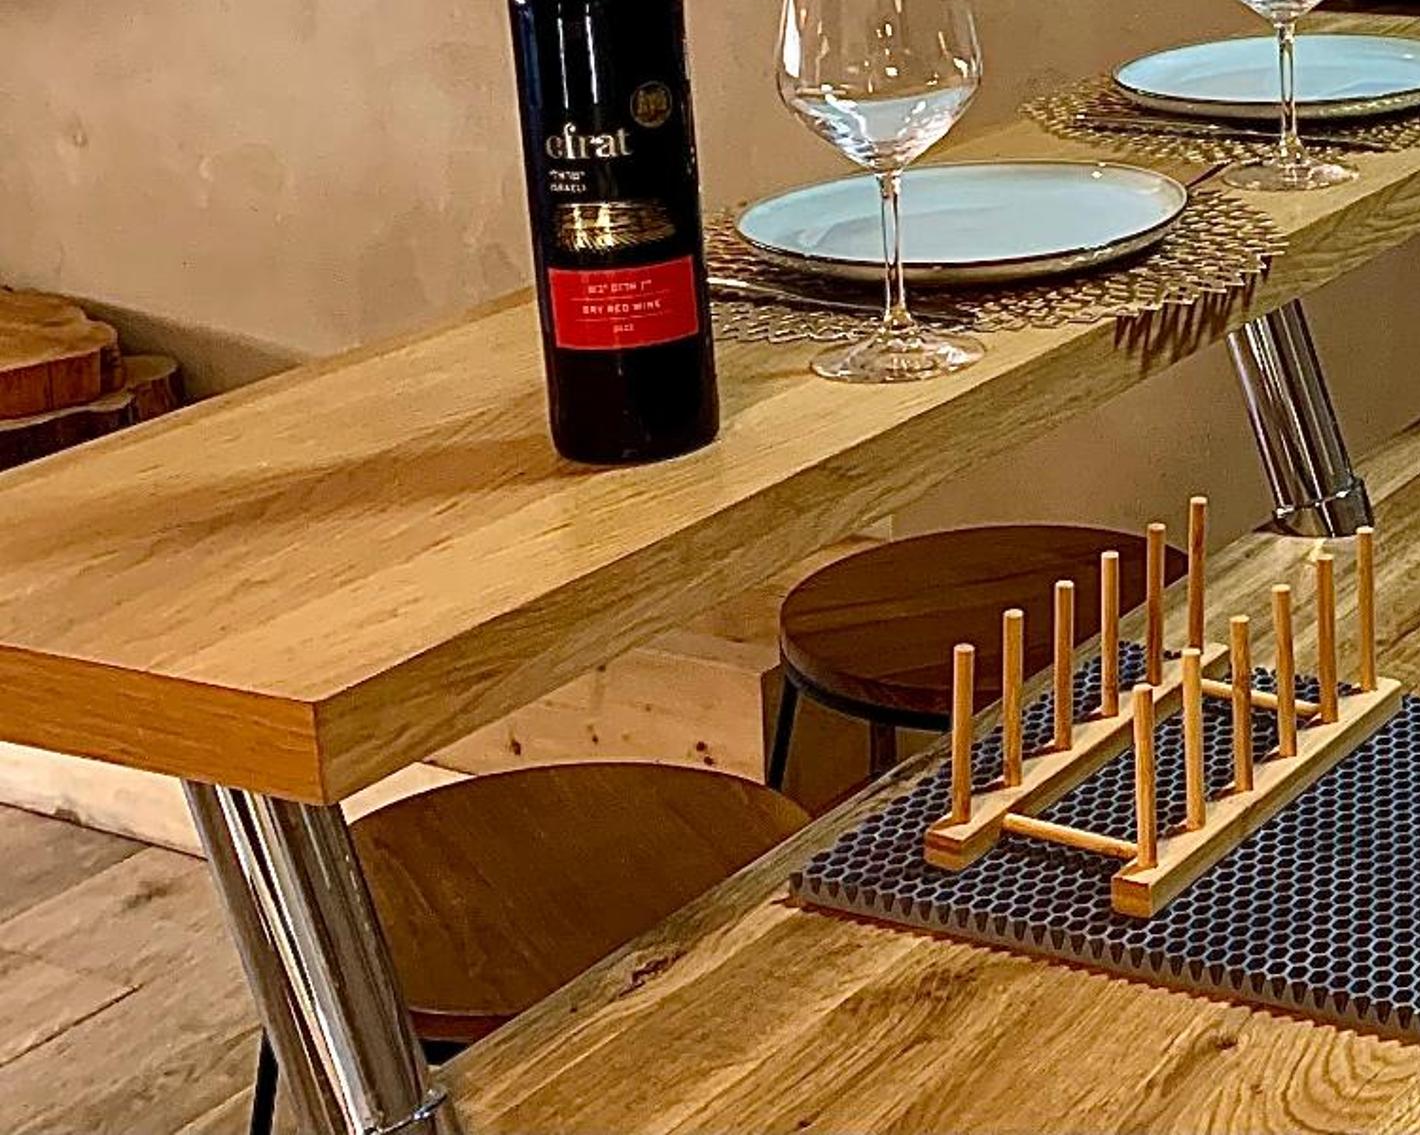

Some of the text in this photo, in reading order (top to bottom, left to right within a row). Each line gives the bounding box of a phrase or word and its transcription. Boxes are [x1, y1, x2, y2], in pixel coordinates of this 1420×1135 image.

[546, 122, 633, 160] efrat
[607, 303, 630, 314] RED
[633, 299, 661, 312] WINE
